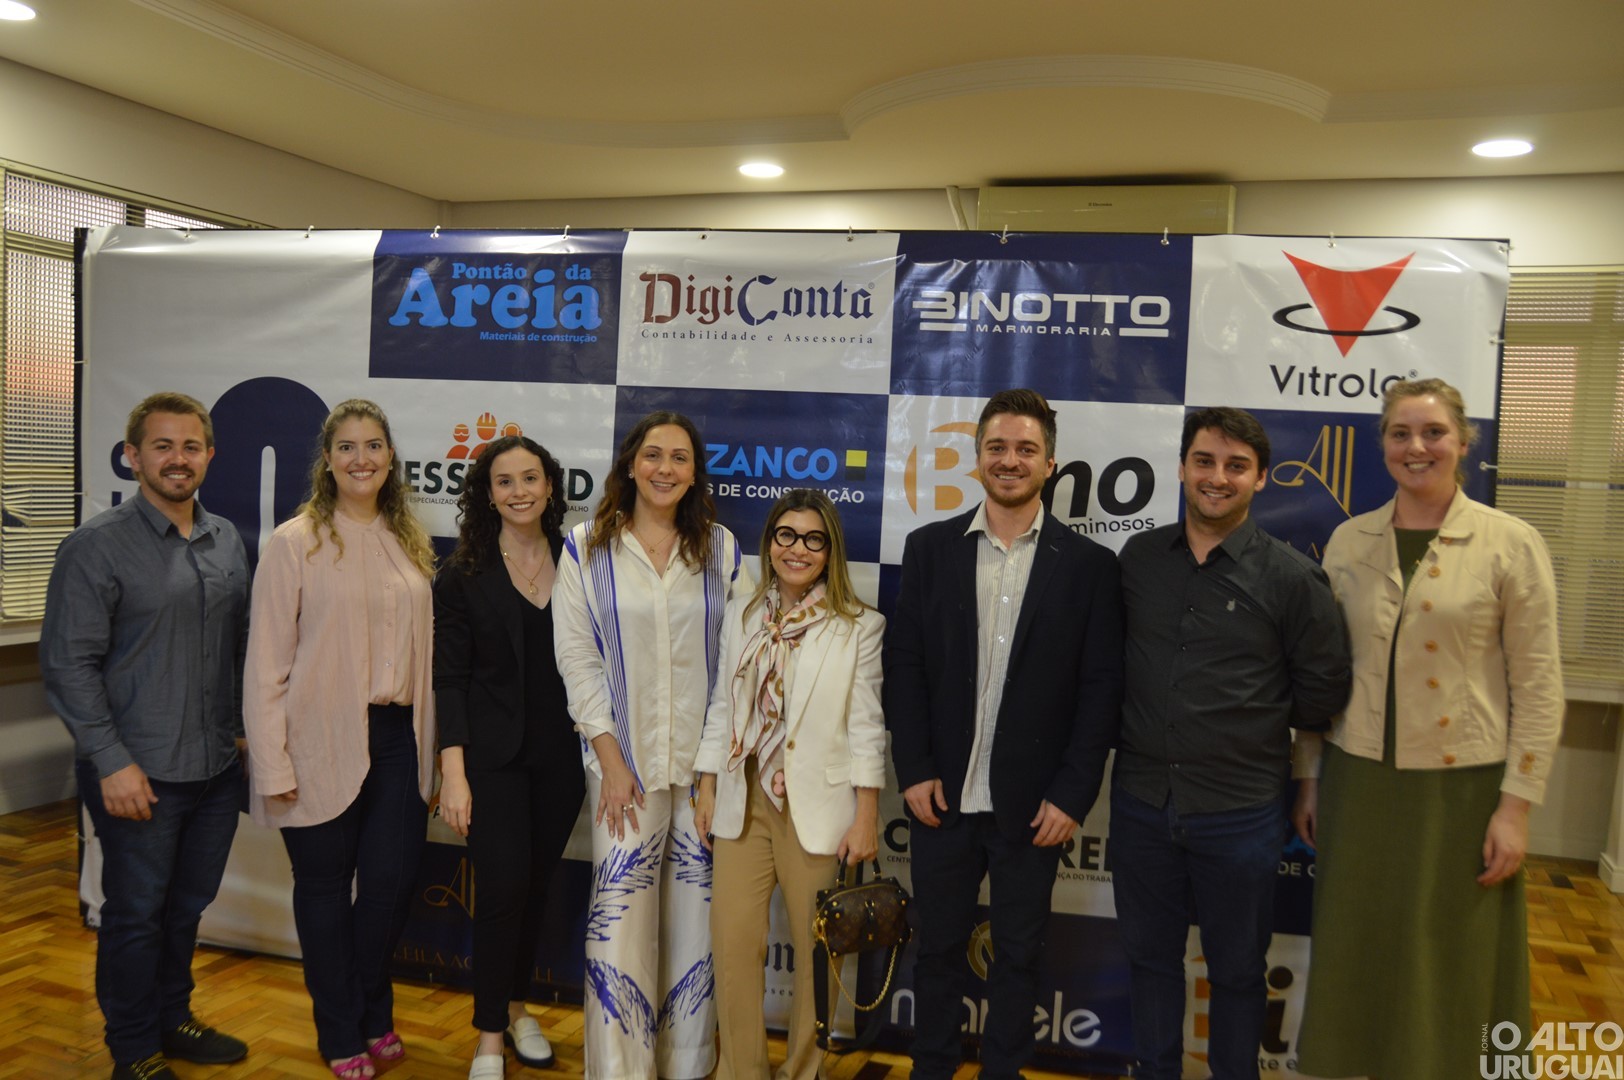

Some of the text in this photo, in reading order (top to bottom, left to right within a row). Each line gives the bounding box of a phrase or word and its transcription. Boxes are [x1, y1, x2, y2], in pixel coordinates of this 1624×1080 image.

[452, 263, 592, 280] Pontão da
[388, 267, 602, 330] Areia
[639, 271, 874, 326] DigiConta
[912, 290, 1171, 326] BINOTTO
[479, 332, 598, 344] Materiais de construção
[641, 329, 874, 344] Contabilidade e Assessoria
[976, 324, 1112, 337] MARMORARIA
[719, 483, 741, 497] DE
[745, 484, 865, 504] CONSÇÃO
[1086, 874, 1112, 883] TRABA
